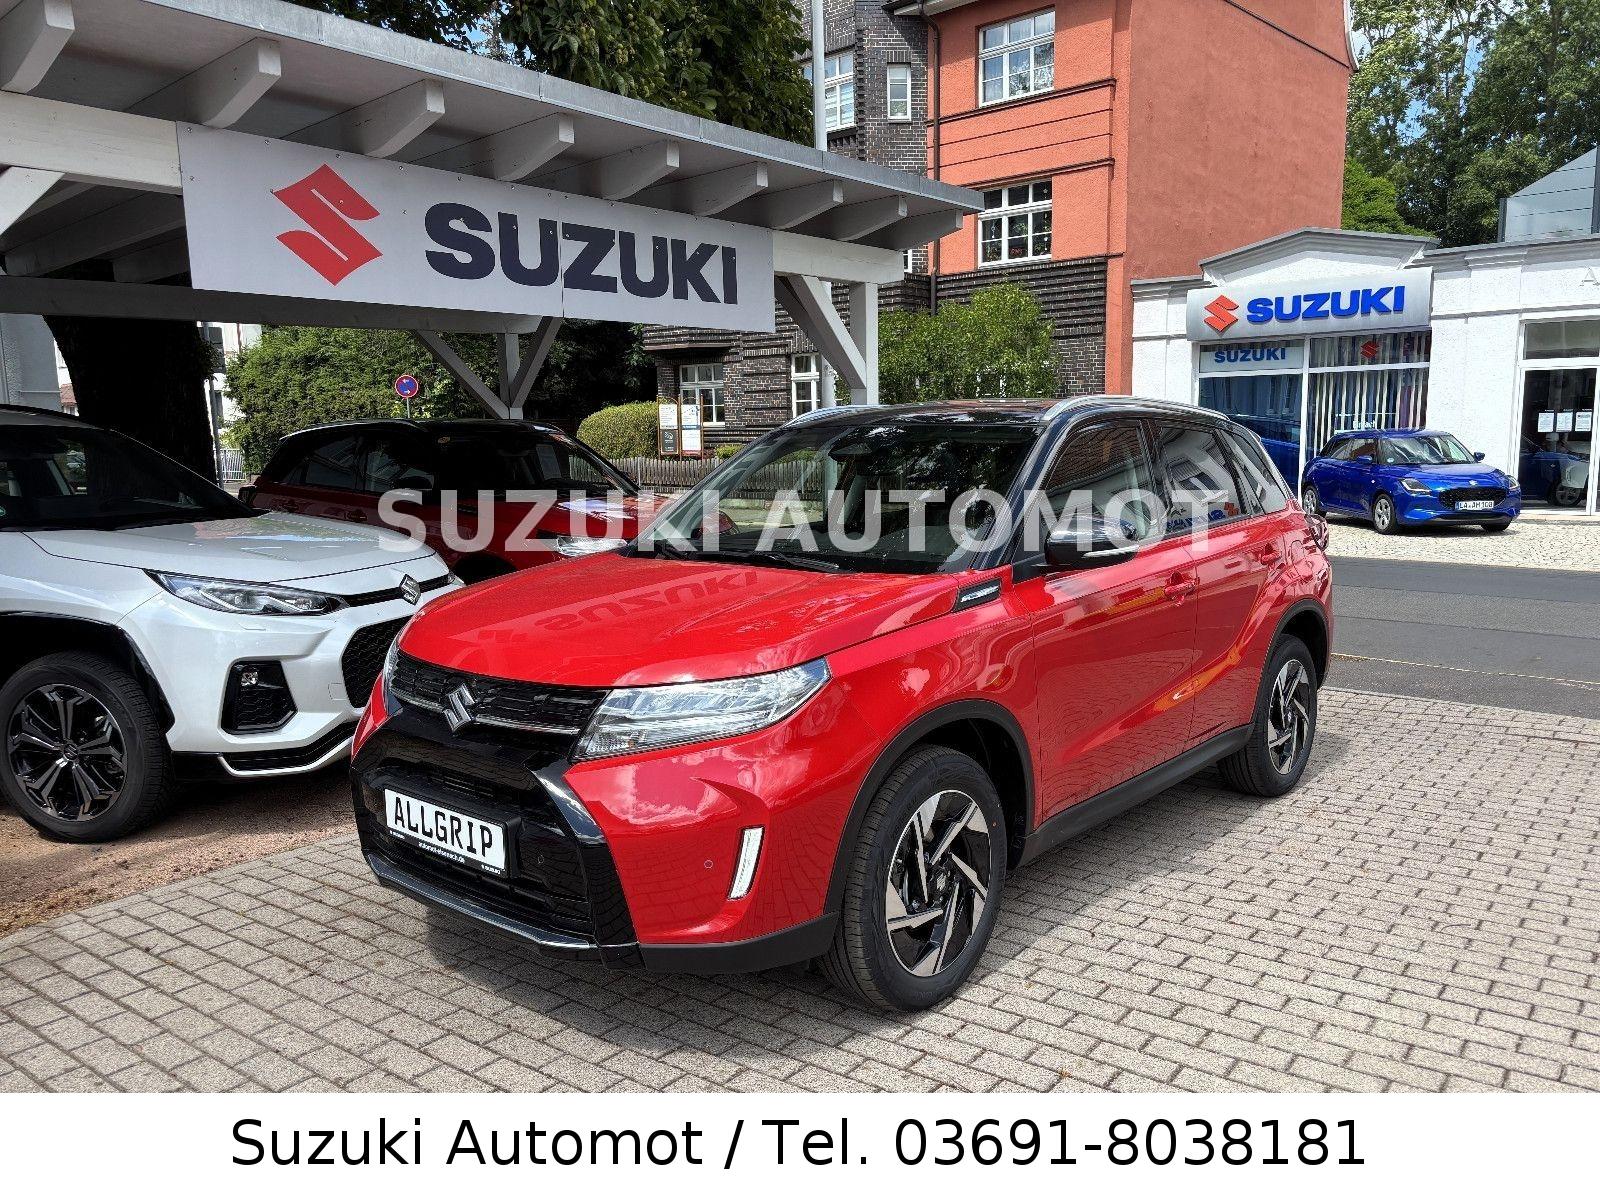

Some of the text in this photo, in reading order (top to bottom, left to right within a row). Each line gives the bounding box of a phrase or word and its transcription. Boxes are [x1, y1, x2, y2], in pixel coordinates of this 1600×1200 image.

[425, 202, 738, 305] SUZUKI
[1246, 285, 1405, 324] SUZUKI
[1214, 346, 1286, 364] SUZUKI
[394, 796, 493, 857] ALLGRIP
